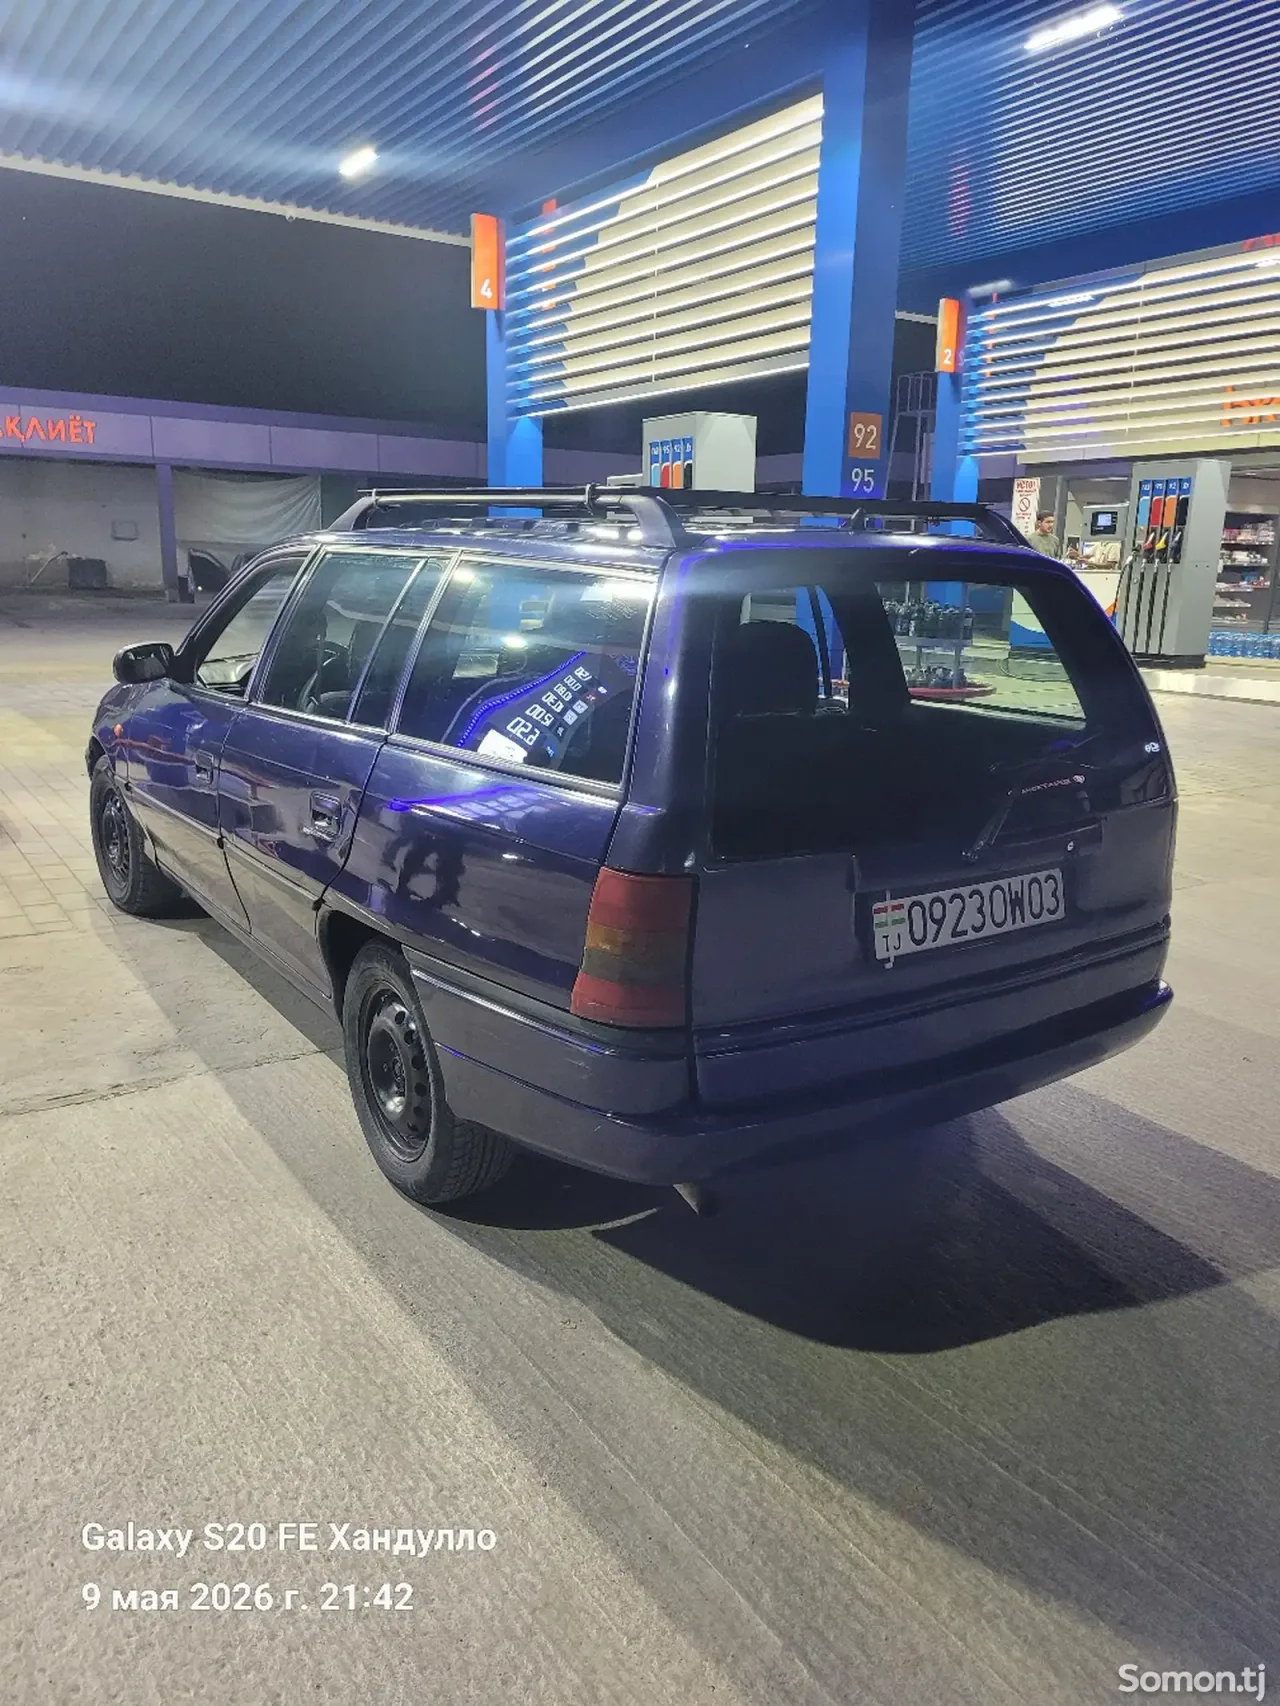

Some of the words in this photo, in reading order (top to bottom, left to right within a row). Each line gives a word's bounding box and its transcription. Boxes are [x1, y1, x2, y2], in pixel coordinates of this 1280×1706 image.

[480, 278, 493, 299] 4
[943, 348, 952, 365] 2
[0, 415, 96, 444] ҚЛИЁТ
[853, 423, 877, 450] 92
[851, 468, 876, 493] 95
[882, 934, 901, 953] TJ
